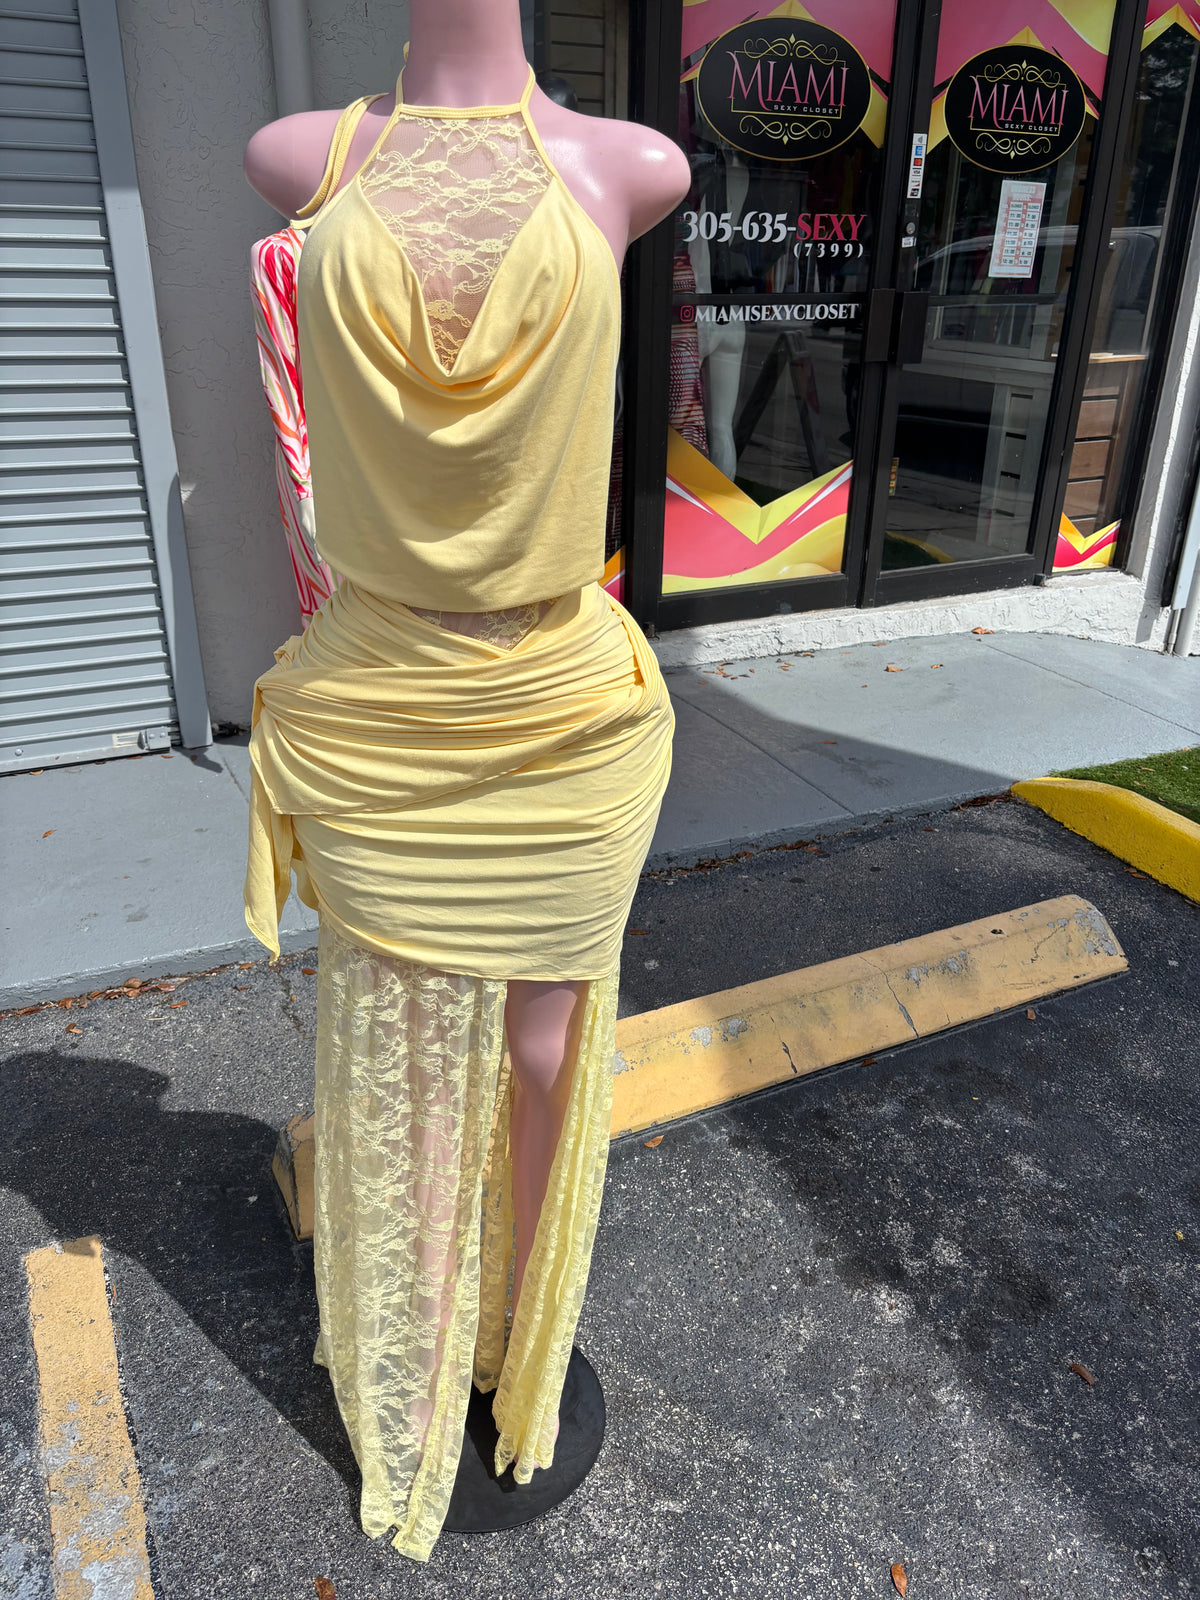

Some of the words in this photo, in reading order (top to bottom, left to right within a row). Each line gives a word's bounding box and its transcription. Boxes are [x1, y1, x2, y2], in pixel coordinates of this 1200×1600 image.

[725, 51, 850, 111] MIAMI
[773, 104, 798, 112] SEXY
[803, 106, 840, 115] CLOSET
[968, 75, 1069, 129] MIAMI
[682, 210, 867, 243] 305-635-SEXY
[793, 243, 864, 258] (7399)
[694, 303, 860, 323] MIAMISEXYCLOSET
